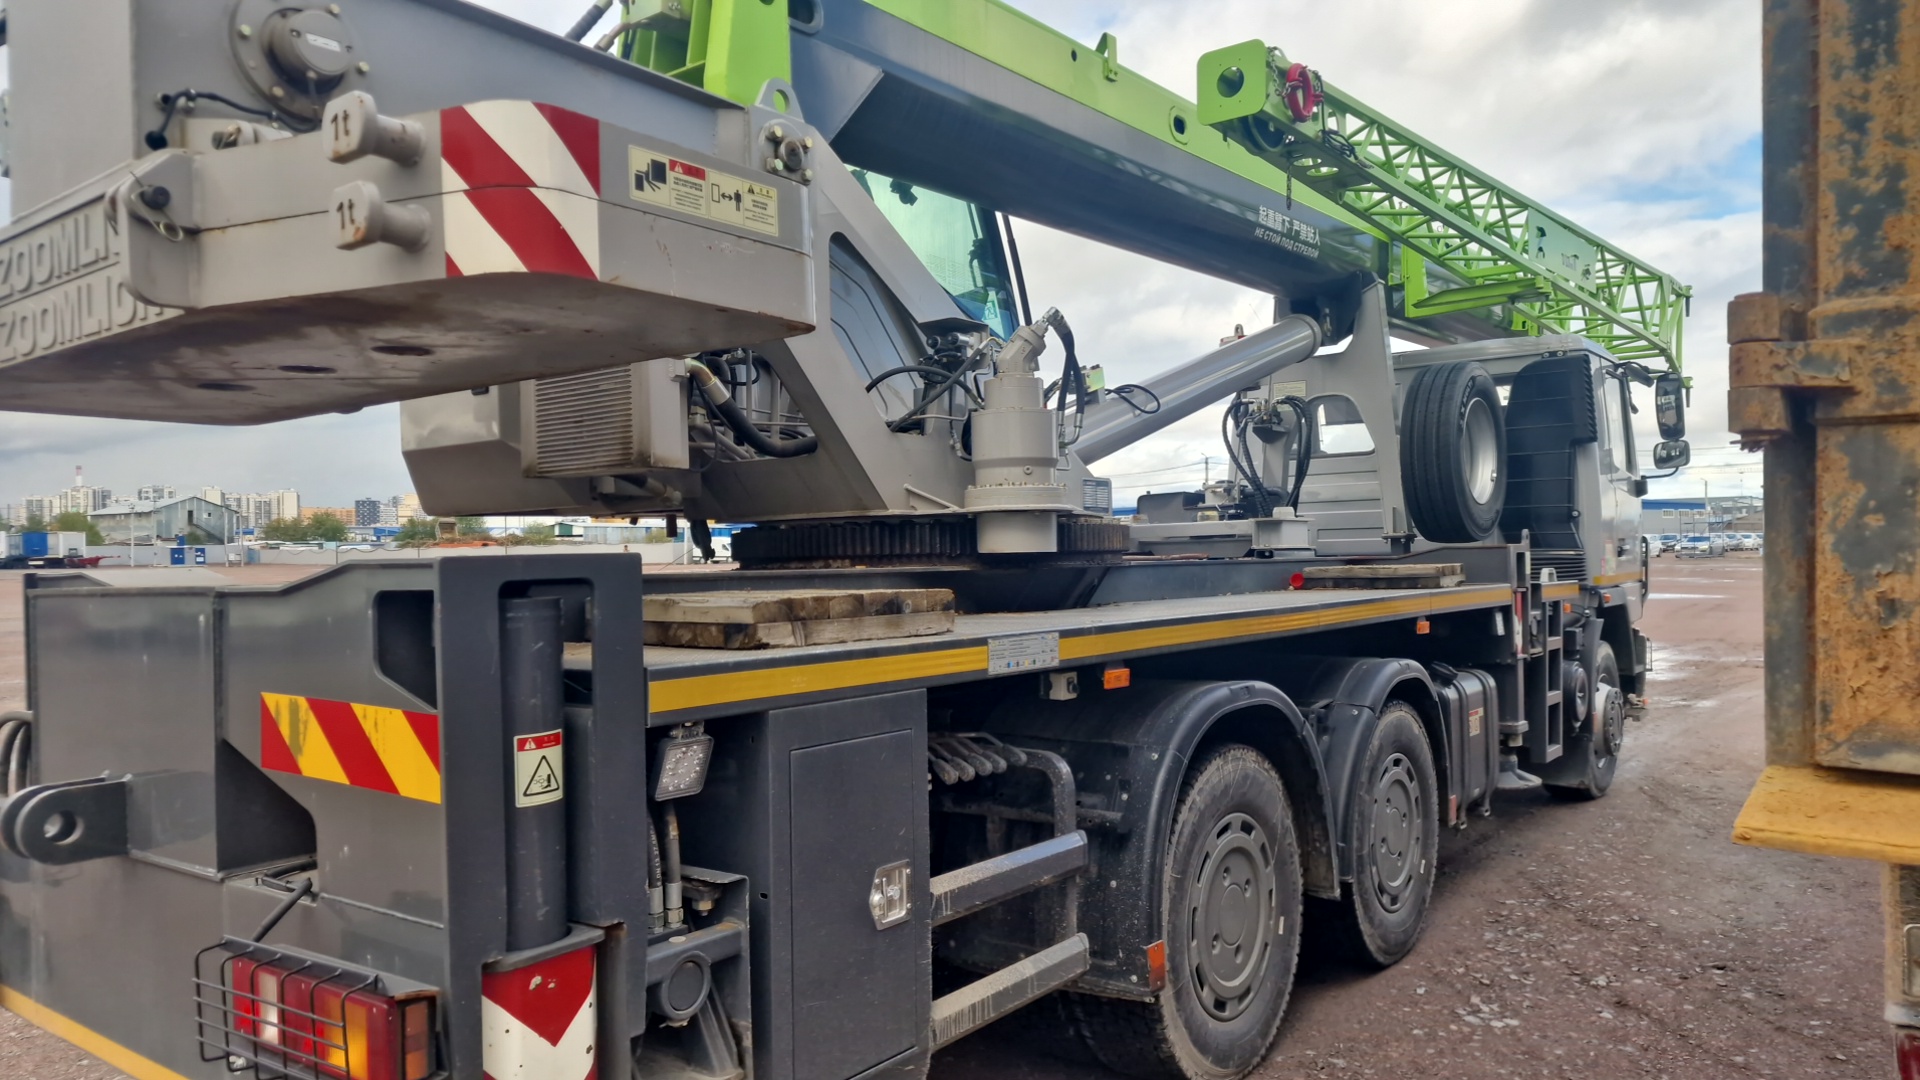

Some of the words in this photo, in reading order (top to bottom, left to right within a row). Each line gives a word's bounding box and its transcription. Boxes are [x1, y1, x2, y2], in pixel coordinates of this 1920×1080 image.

[331, 109, 350, 141] 1t
[336, 198, 355, 230] 1t
[1254, 227, 1264, 239] НЕ
[1264, 231, 1281, 244] СТОЙ
[1280, 238, 1293, 251] ПОД
[1293, 242, 1319, 259] СТРЕЛОЙ
[0, 275, 164, 363] ZOOMLIO
